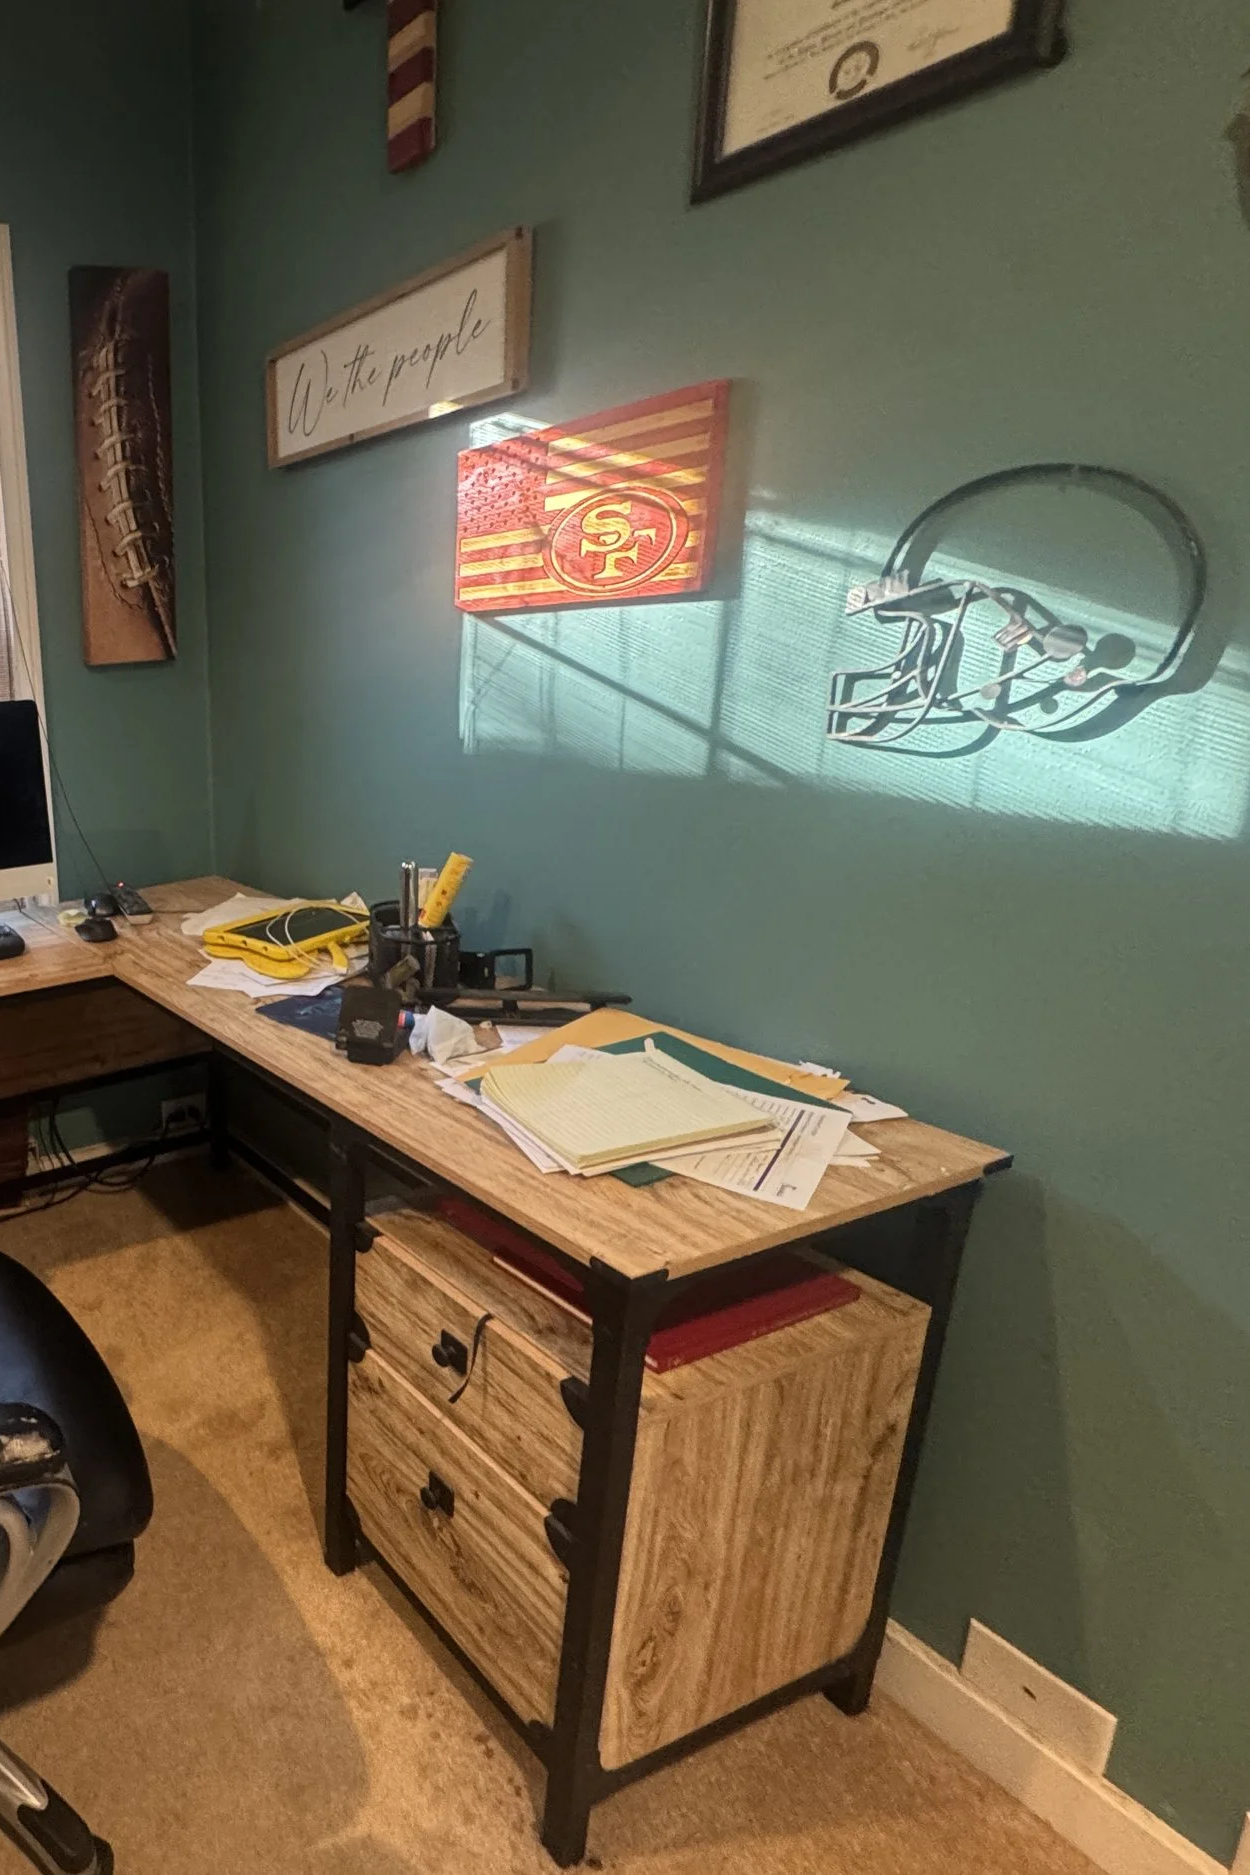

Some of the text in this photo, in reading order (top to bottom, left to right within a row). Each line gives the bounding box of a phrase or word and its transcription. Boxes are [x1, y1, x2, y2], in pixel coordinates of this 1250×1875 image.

[288, 288, 491, 436] We the people
[580, 501, 656, 579] SF
